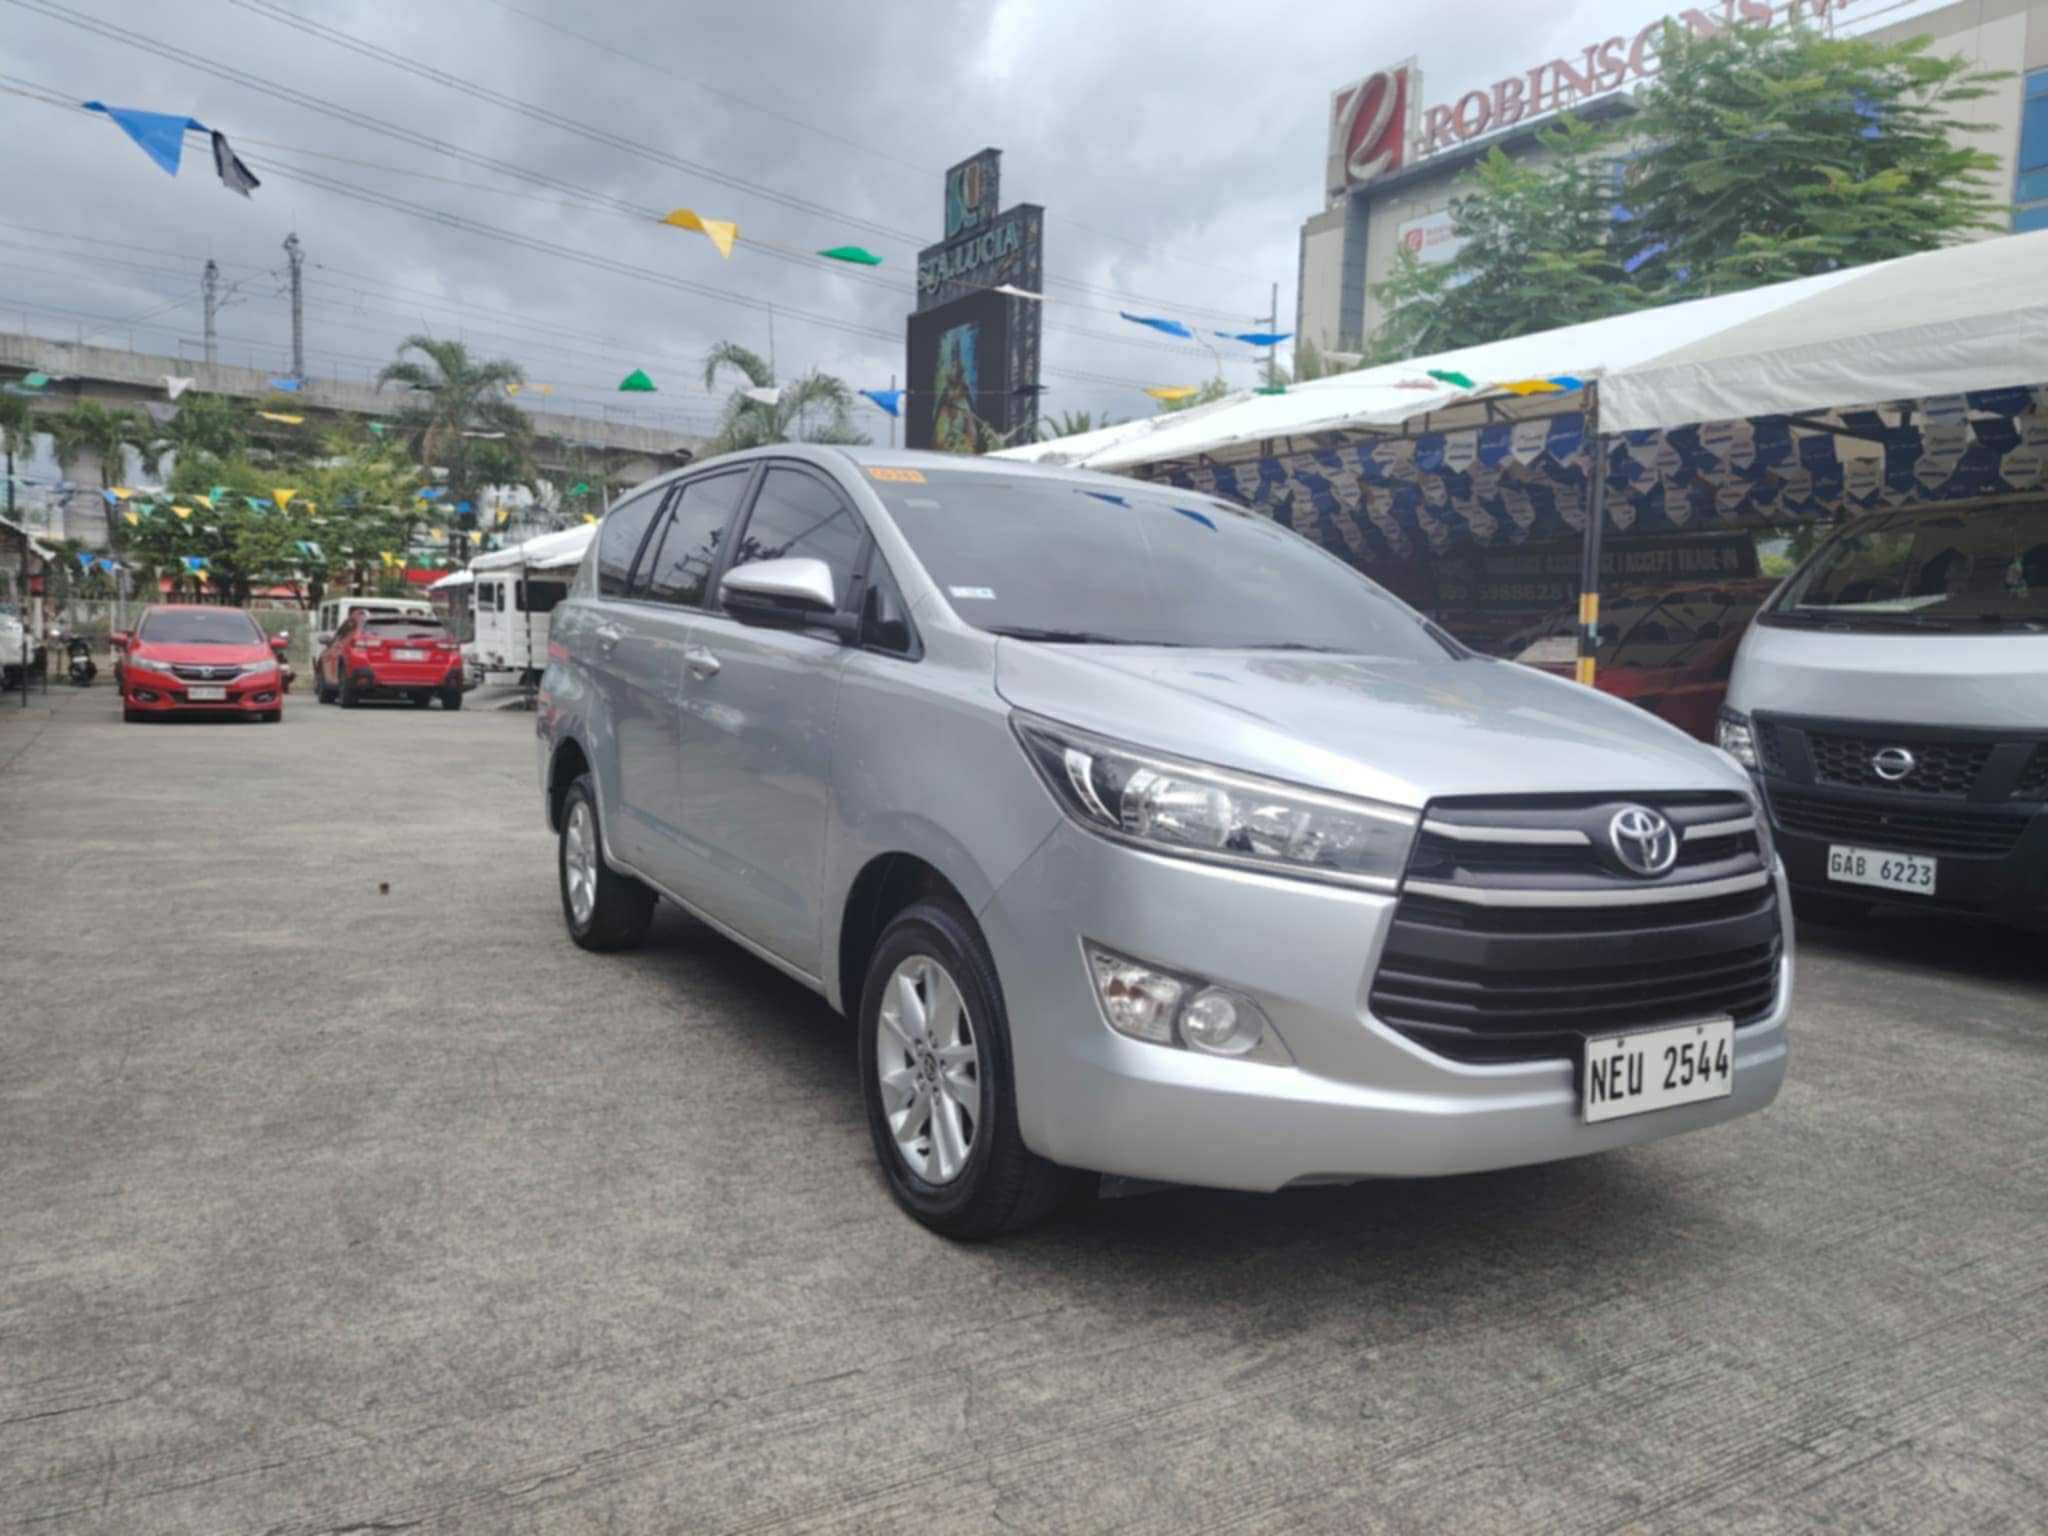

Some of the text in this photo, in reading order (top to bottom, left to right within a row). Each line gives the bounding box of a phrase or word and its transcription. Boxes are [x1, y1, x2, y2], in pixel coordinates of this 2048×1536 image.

[955, 220, 1019, 276] LUCIA
[1830, 852, 1932, 887] GAB 6223
[1590, 1038, 1729, 1104] NEU 2544
